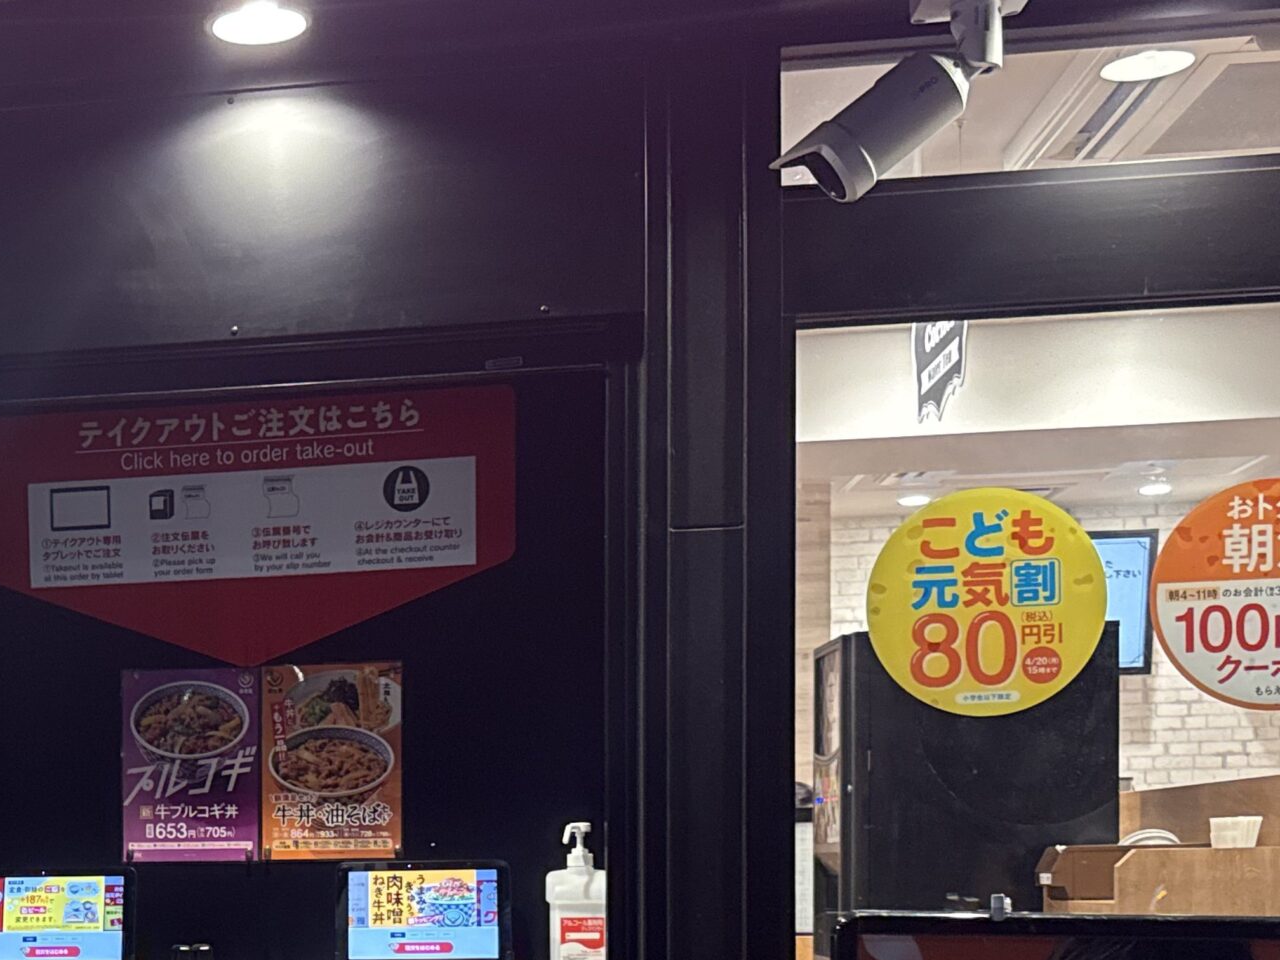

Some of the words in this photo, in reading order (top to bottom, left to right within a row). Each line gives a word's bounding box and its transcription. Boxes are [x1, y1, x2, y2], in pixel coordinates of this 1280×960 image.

[78, 399, 420, 448] テイクアウトご注文はこちら
[121, 452, 163, 470] Click
[170, 449, 210, 467] here
[217, 449, 234, 464] to
[240, 446, 288, 463] order
[296, 438, 374, 460] take-out
[919, 509, 1055, 559] こども
[1222, 523, 1280, 573] 朝
[911, 560, 1061, 609] 元気割
[910, 610, 1017, 688] 80
[1021, 623, 1063, 644] 円引
[372, 874, 386, 924] ねぎ牛丼
[386, 874, 404, 924] 肉味噌
